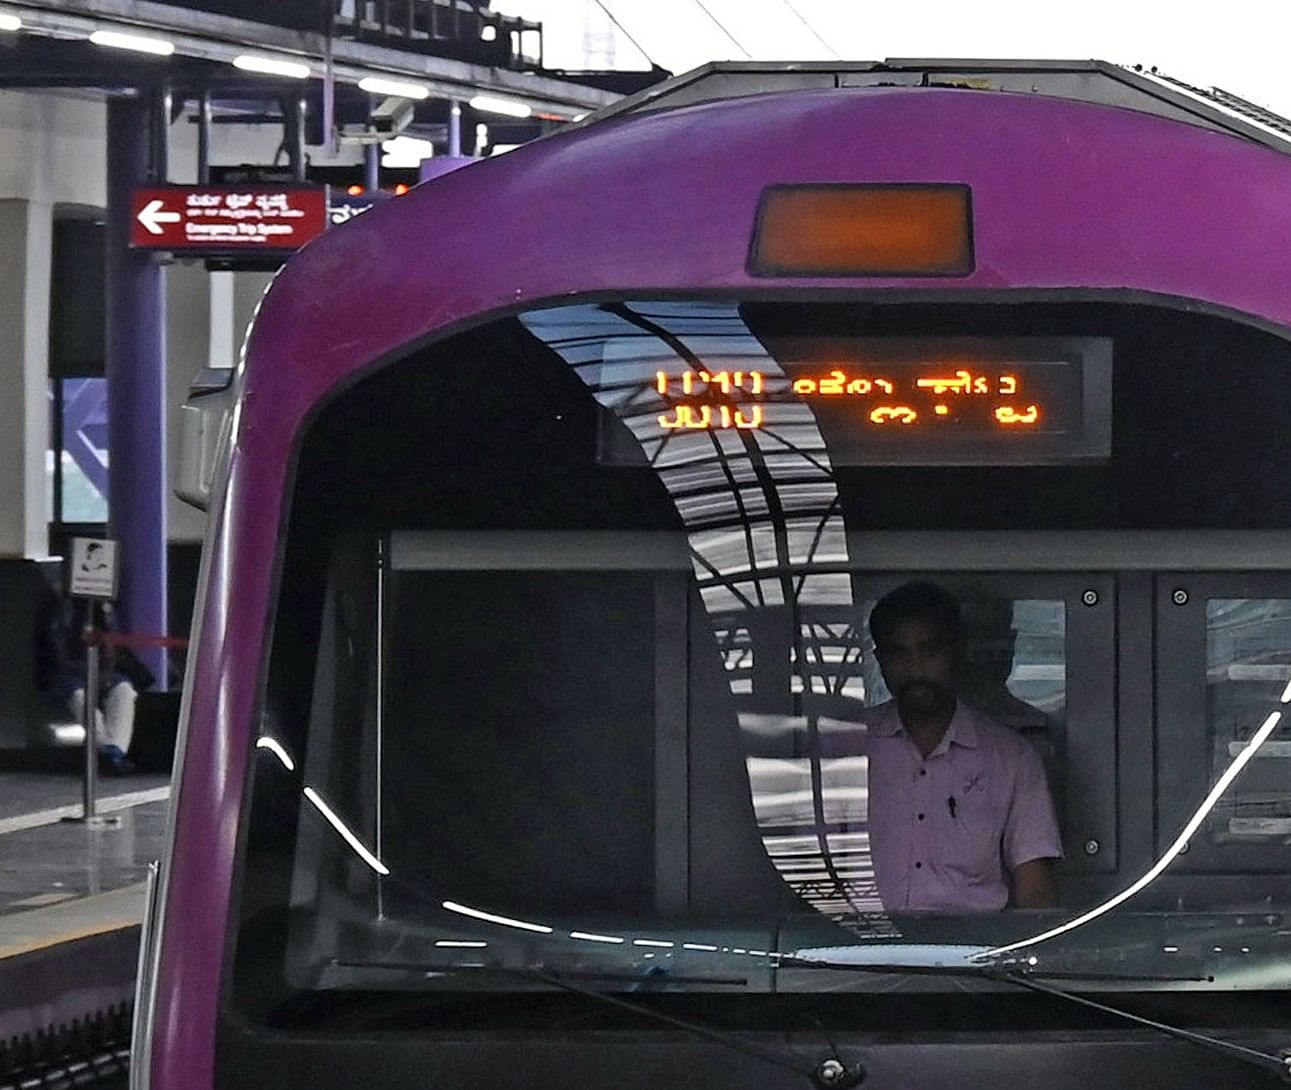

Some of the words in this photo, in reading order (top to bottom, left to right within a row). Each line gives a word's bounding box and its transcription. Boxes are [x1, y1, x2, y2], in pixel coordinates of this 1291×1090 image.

[185, 222, 238, 235] Emergency
[238, 222, 258, 235] Trip
[257, 223, 294, 234] System
